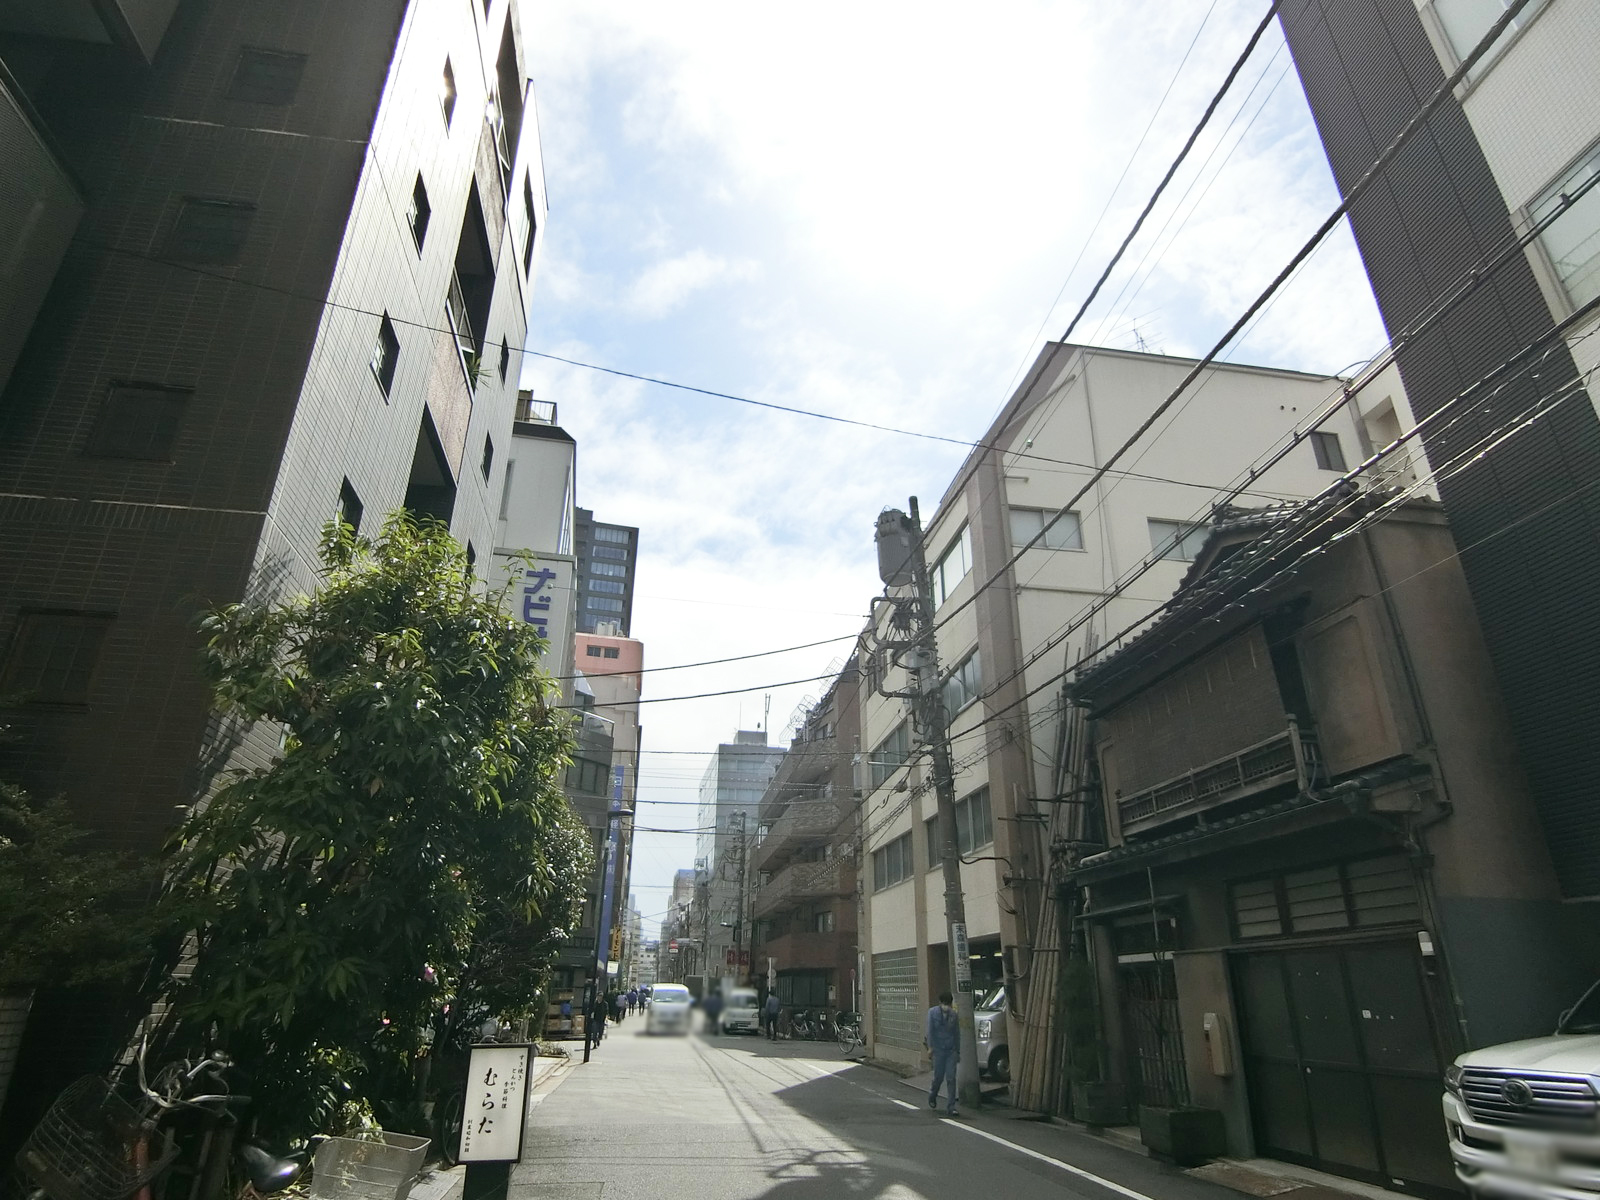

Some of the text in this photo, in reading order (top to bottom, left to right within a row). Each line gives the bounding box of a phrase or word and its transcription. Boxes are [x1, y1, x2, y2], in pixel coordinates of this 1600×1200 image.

[523, 568, 556, 638] ナビ
[509, 1068, 517, 1091] とんかつ
[517, 1054, 525, 1081] すき焼き
[478, 1067, 498, 1134] むらた
